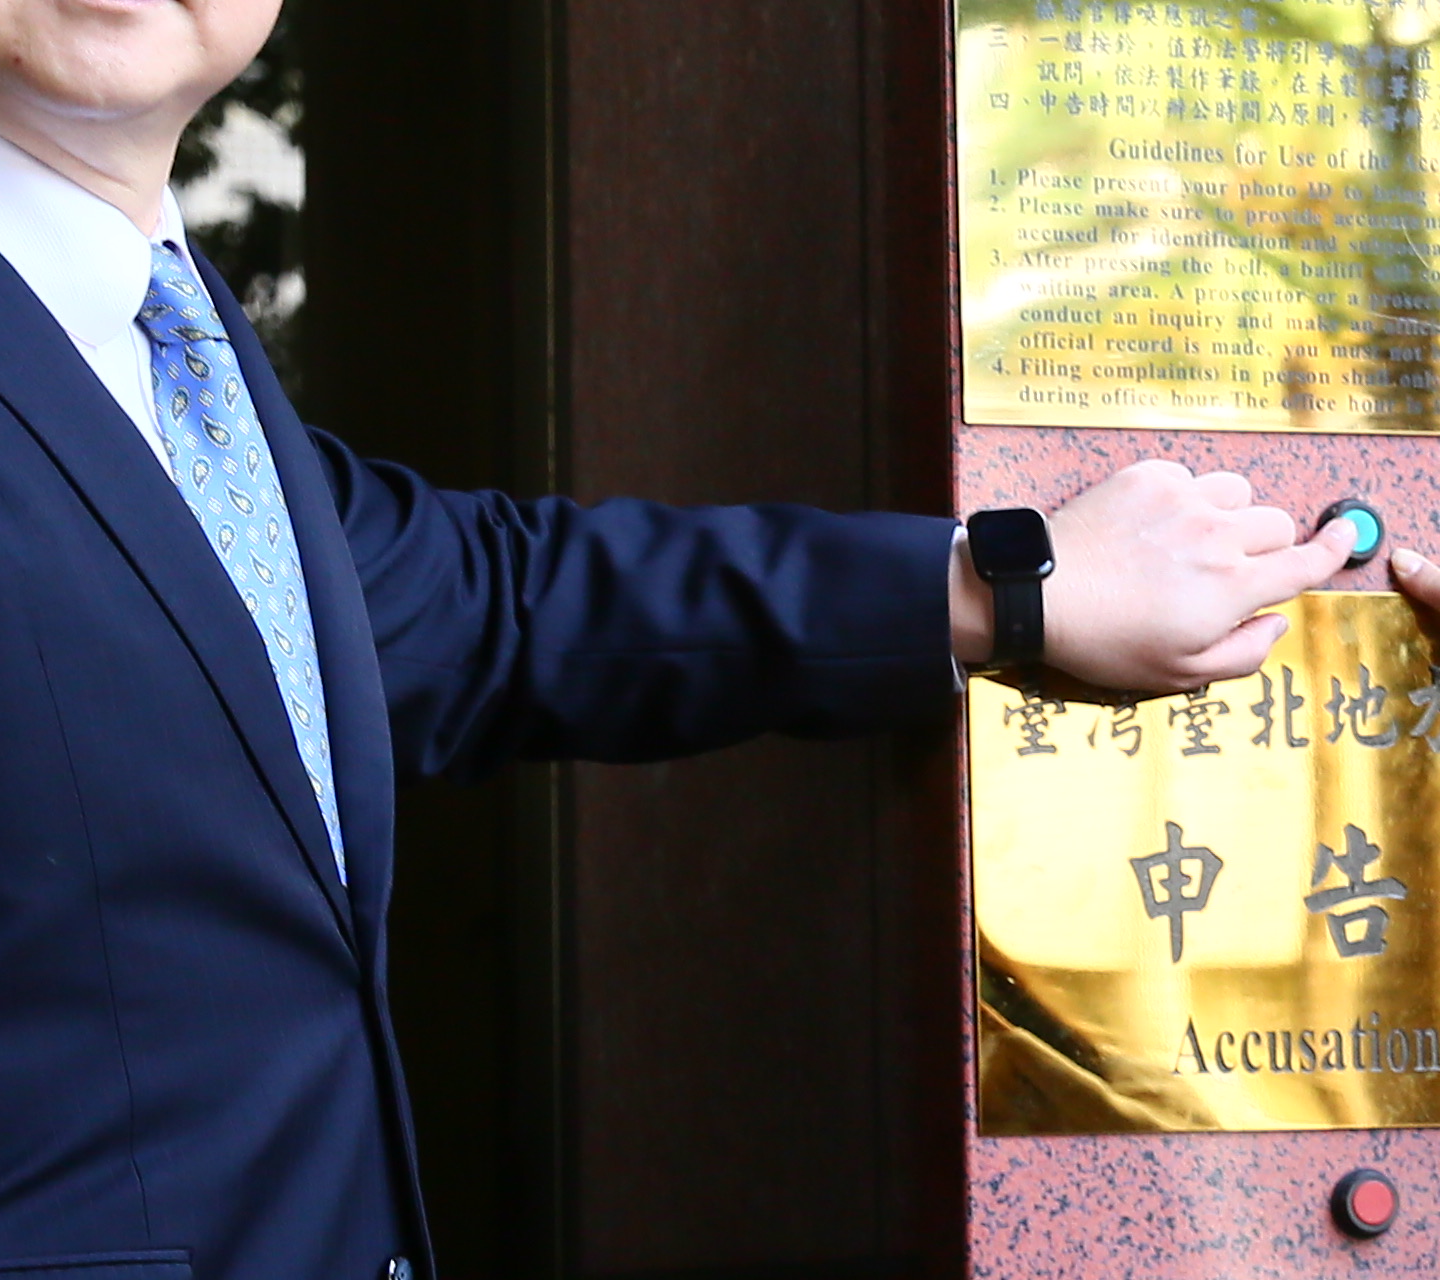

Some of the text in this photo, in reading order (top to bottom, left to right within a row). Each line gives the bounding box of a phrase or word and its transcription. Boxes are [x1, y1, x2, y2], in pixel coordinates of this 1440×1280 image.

[1109, 138, 1224, 163] Guidelines
[1236, 144, 1267, 165] for
[1279, 145, 1317, 167] Use
[1327, 146, 1348, 169] of
[1360, 149, 1390, 170] the
[989, 168, 1006, 186] 1.
[1017, 168, 1083, 189] Please
[1093, 175, 1169, 195] present
[1181, 180, 1228, 198] your
[1239, 179, 1297, 199] photo
[1308, 181, 1333, 200] ID
[1344, 184, 1362, 201] to
[989, 195, 1006, 212] 2.
[1018, 196, 1083, 216] Please
[1094, 200, 1150, 218] make
[1160, 204, 1204, 220] sure
[1215, 206, 1234, 222] to
[1246, 208, 1322, 228] provide
[1017, 225, 1098, 243] accused
[1110, 228, 1140, 244] for
[1151, 227, 1291, 251] identification
[1300, 235, 1338, 252] and
[989, 248, 1008, 267] 3.
[1018, 251, 1073, 268] After
[1084, 259, 1172, 277] pressing
[1182, 257, 1213, 274] the
[1279, 263, 1290, 277] a
[1020, 281, 1098, 303] waiting
[1170, 283, 1185, 300] A
[1194, 288, 1306, 306] prosecutor
[1316, 290, 1337, 305] or
[1348, 292, 1359, 305] a
[1020, 306, 1103, 324] conduct
[1112, 312, 1138, 326] an
[1148, 308, 1226, 332] inquiry
[1237, 312, 1273, 330] and
[1286, 314, 1340, 333] make
[1350, 319, 1372, 333] an
[1020, 332, 1095, 351] official
[1105, 336, 1173, 354] record
[1184, 336, 1200, 355] is
[1284, 343, 1318, 363] you
[1330, 343, 1382, 360] must
[1389, 345, 1423, 362] not
[991, 357, 1011, 377] 4.
[1020, 356, 1082, 383] Filing
[1092, 362, 1220, 383] complaint(s)
[1230, 365, 1251, 382] in
[1262, 370, 1331, 388] person
[1018, 385, 1089, 407] during
[1101, 388, 1159, 407] office
[1230, 391, 1268, 409] The
[1280, 394, 1336, 412] office
[1348, 394, 1396, 414] hour
